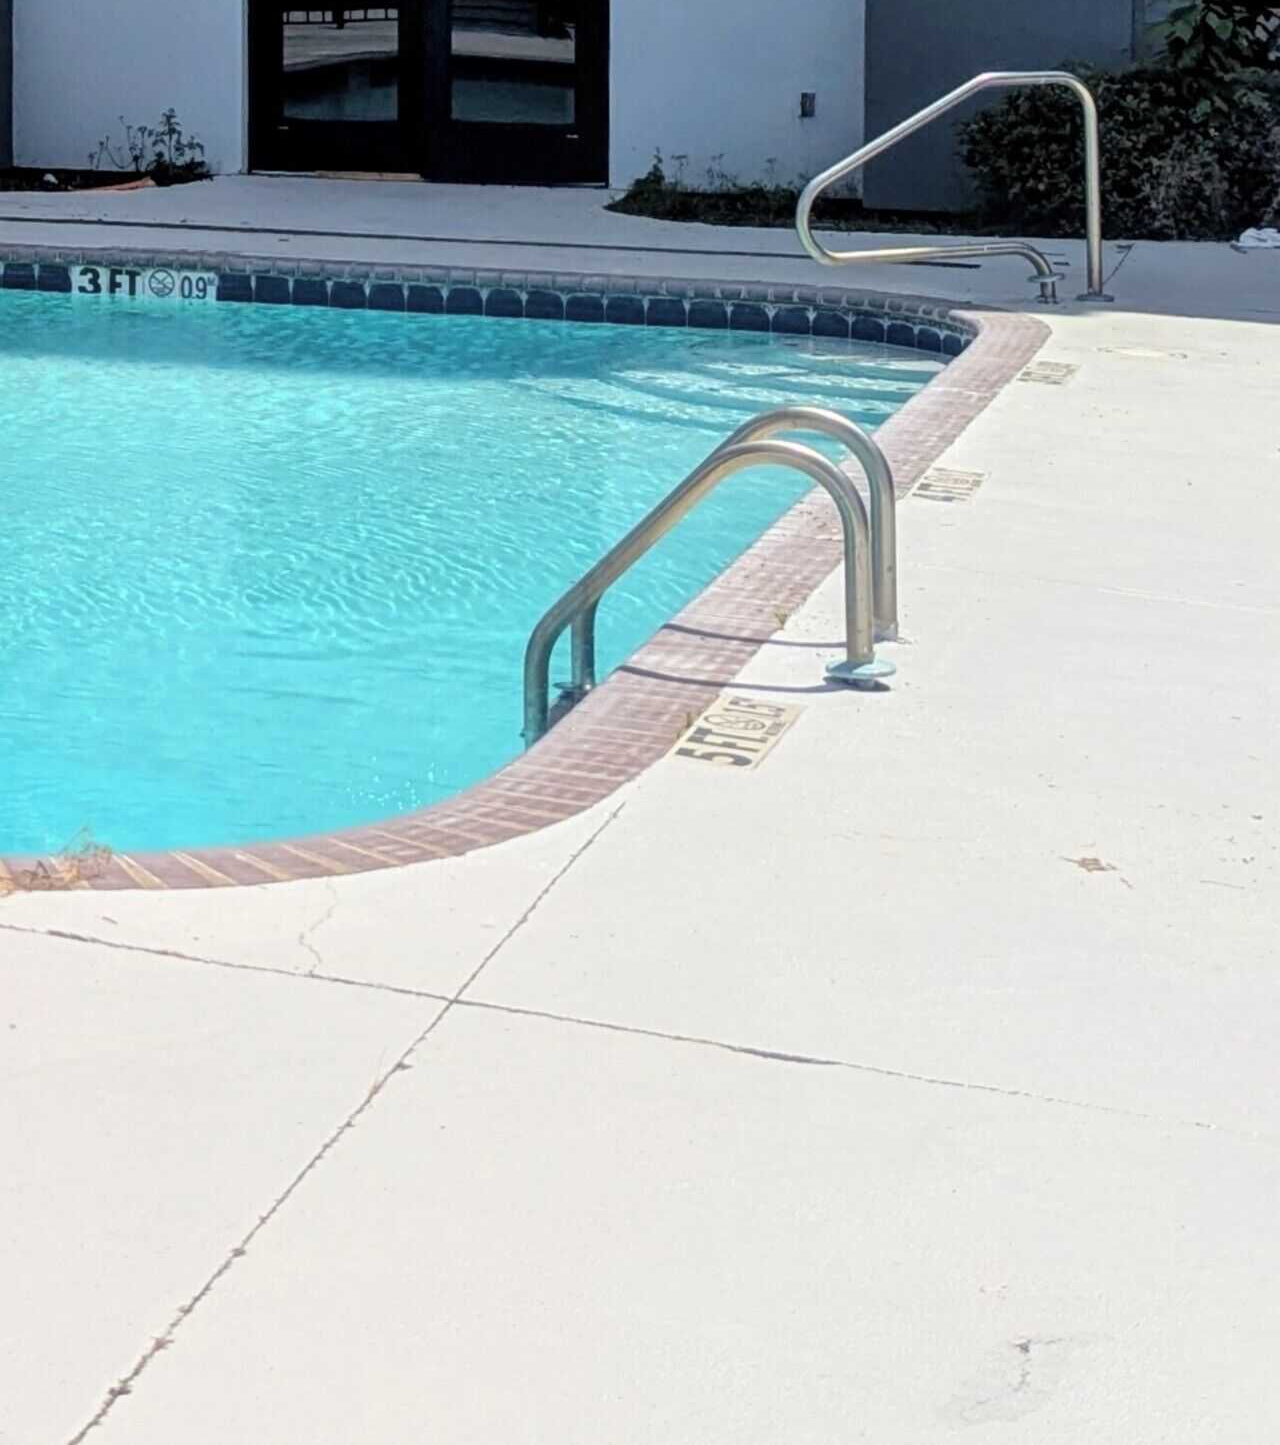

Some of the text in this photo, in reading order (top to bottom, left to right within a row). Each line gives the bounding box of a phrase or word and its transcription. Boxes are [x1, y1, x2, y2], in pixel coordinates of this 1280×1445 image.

[78, 267, 102, 294] 3
[109, 269, 141, 296] FT
[675, 746, 754, 767] 5
